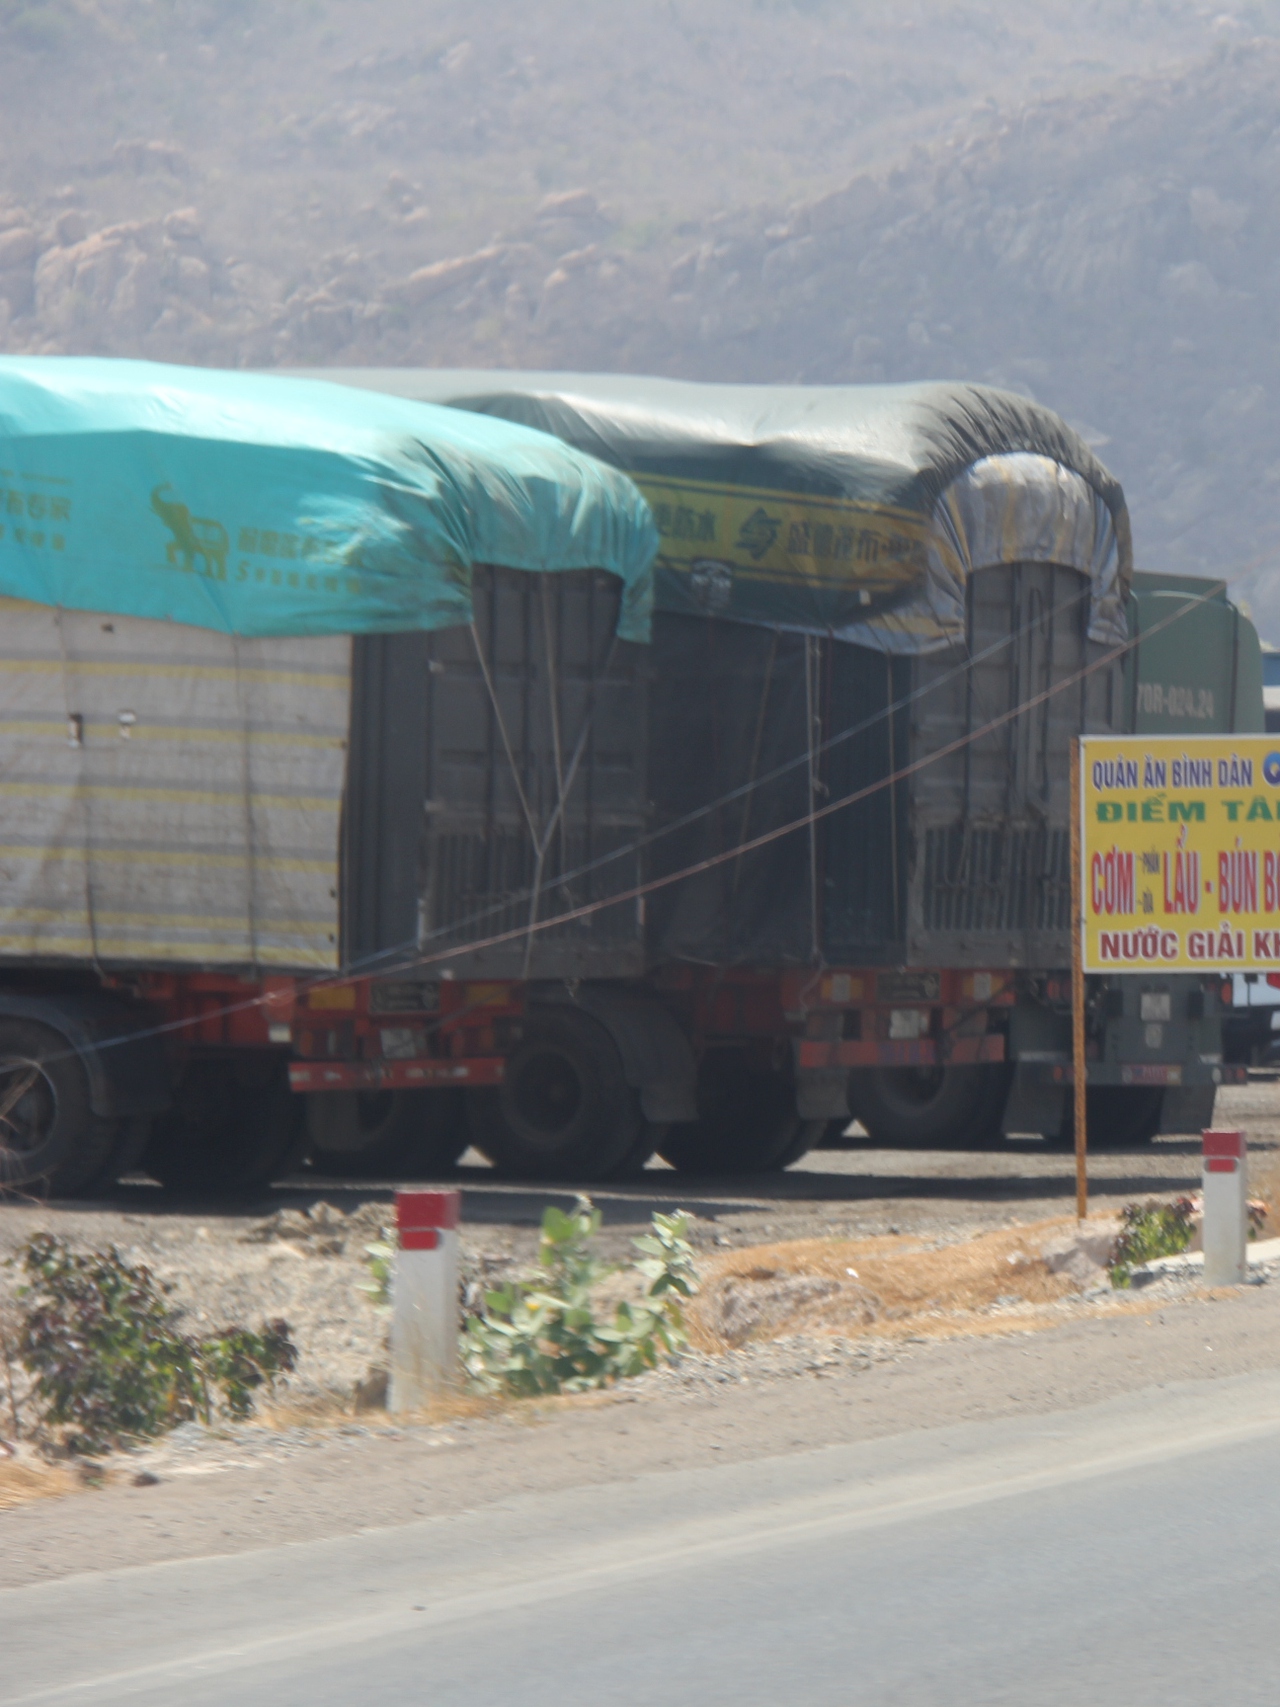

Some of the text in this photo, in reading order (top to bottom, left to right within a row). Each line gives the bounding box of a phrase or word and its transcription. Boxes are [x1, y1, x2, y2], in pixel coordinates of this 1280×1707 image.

[1092, 754, 1138, 791] QUÁN
[1144, 753, 1167, 788] ĂN
[1172, 753, 1212, 788] BÌNH
[1218, 753, 1252, 788] DÂN
[1095, 792, 1206, 823] ĐIỂM
[1091, 844, 1136, 915] CƠM
[1163, 824, 1200, 915] LẨU
[1218, 836, 1258, 915] BÚN
[1100, 925, 1178, 960] NƯỚC
[1188, 922, 1244, 960] GIẢI
